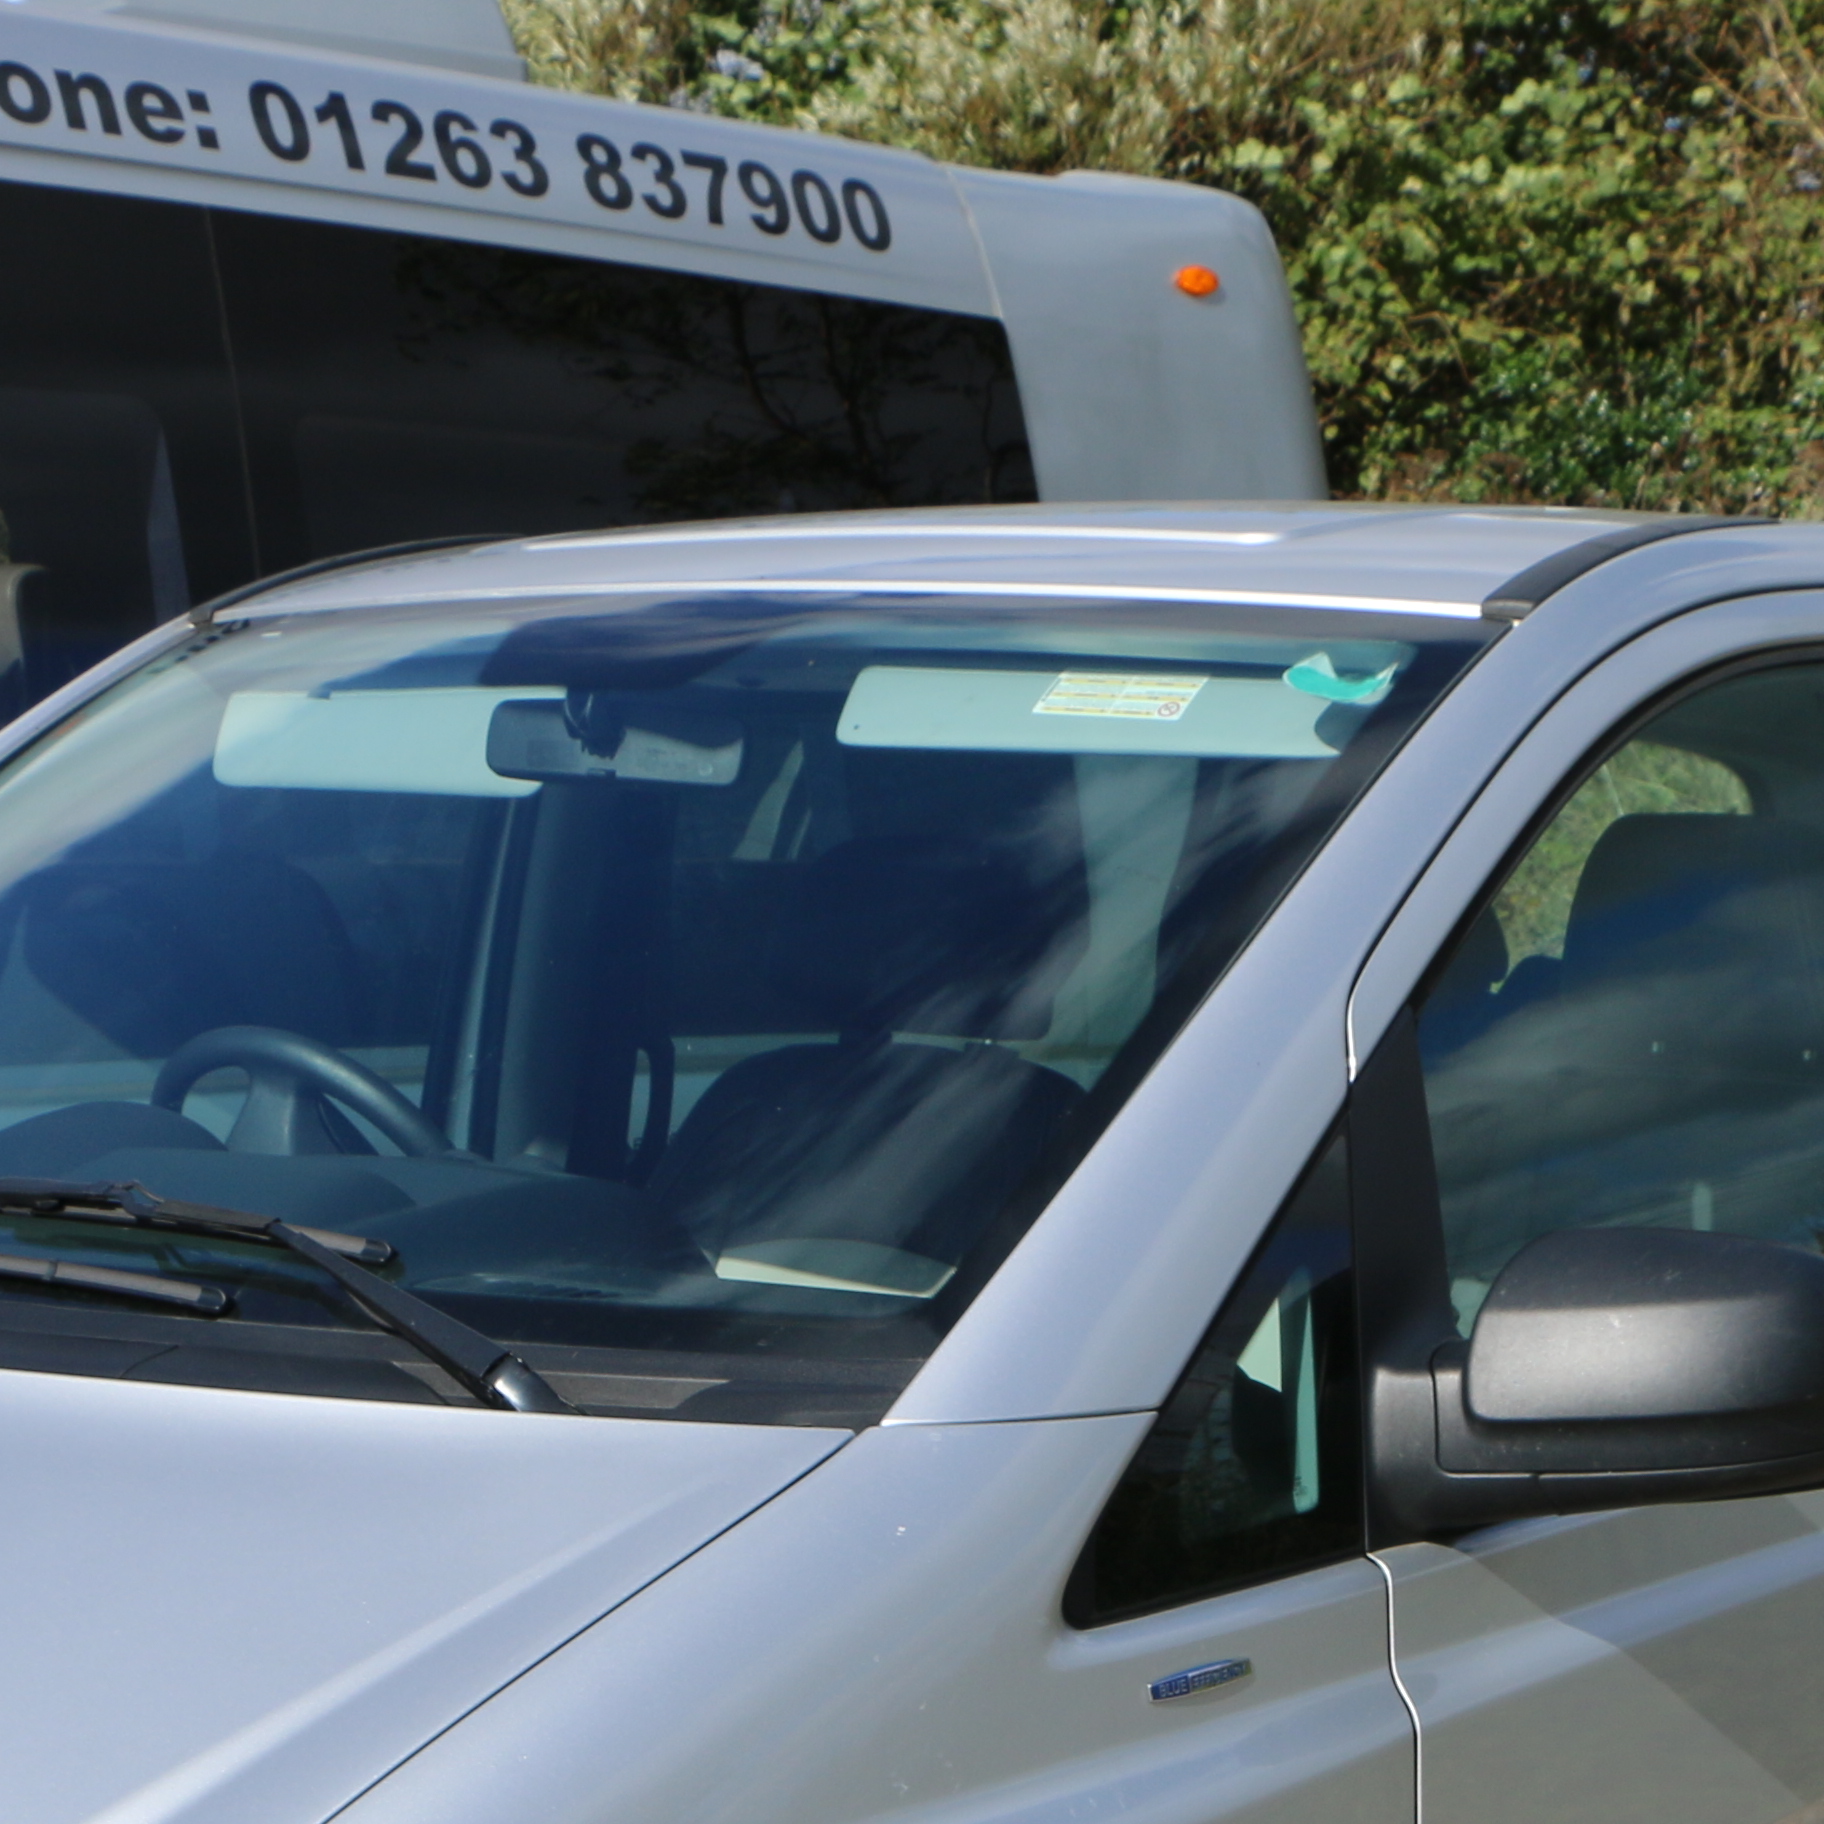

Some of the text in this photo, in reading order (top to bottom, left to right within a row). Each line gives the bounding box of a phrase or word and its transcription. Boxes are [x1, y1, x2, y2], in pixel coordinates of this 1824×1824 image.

[247, 79, 551, 199] 01263
[574, 133, 893, 253] 837900
[1159, 1678, 1188, 1698] BLUE
